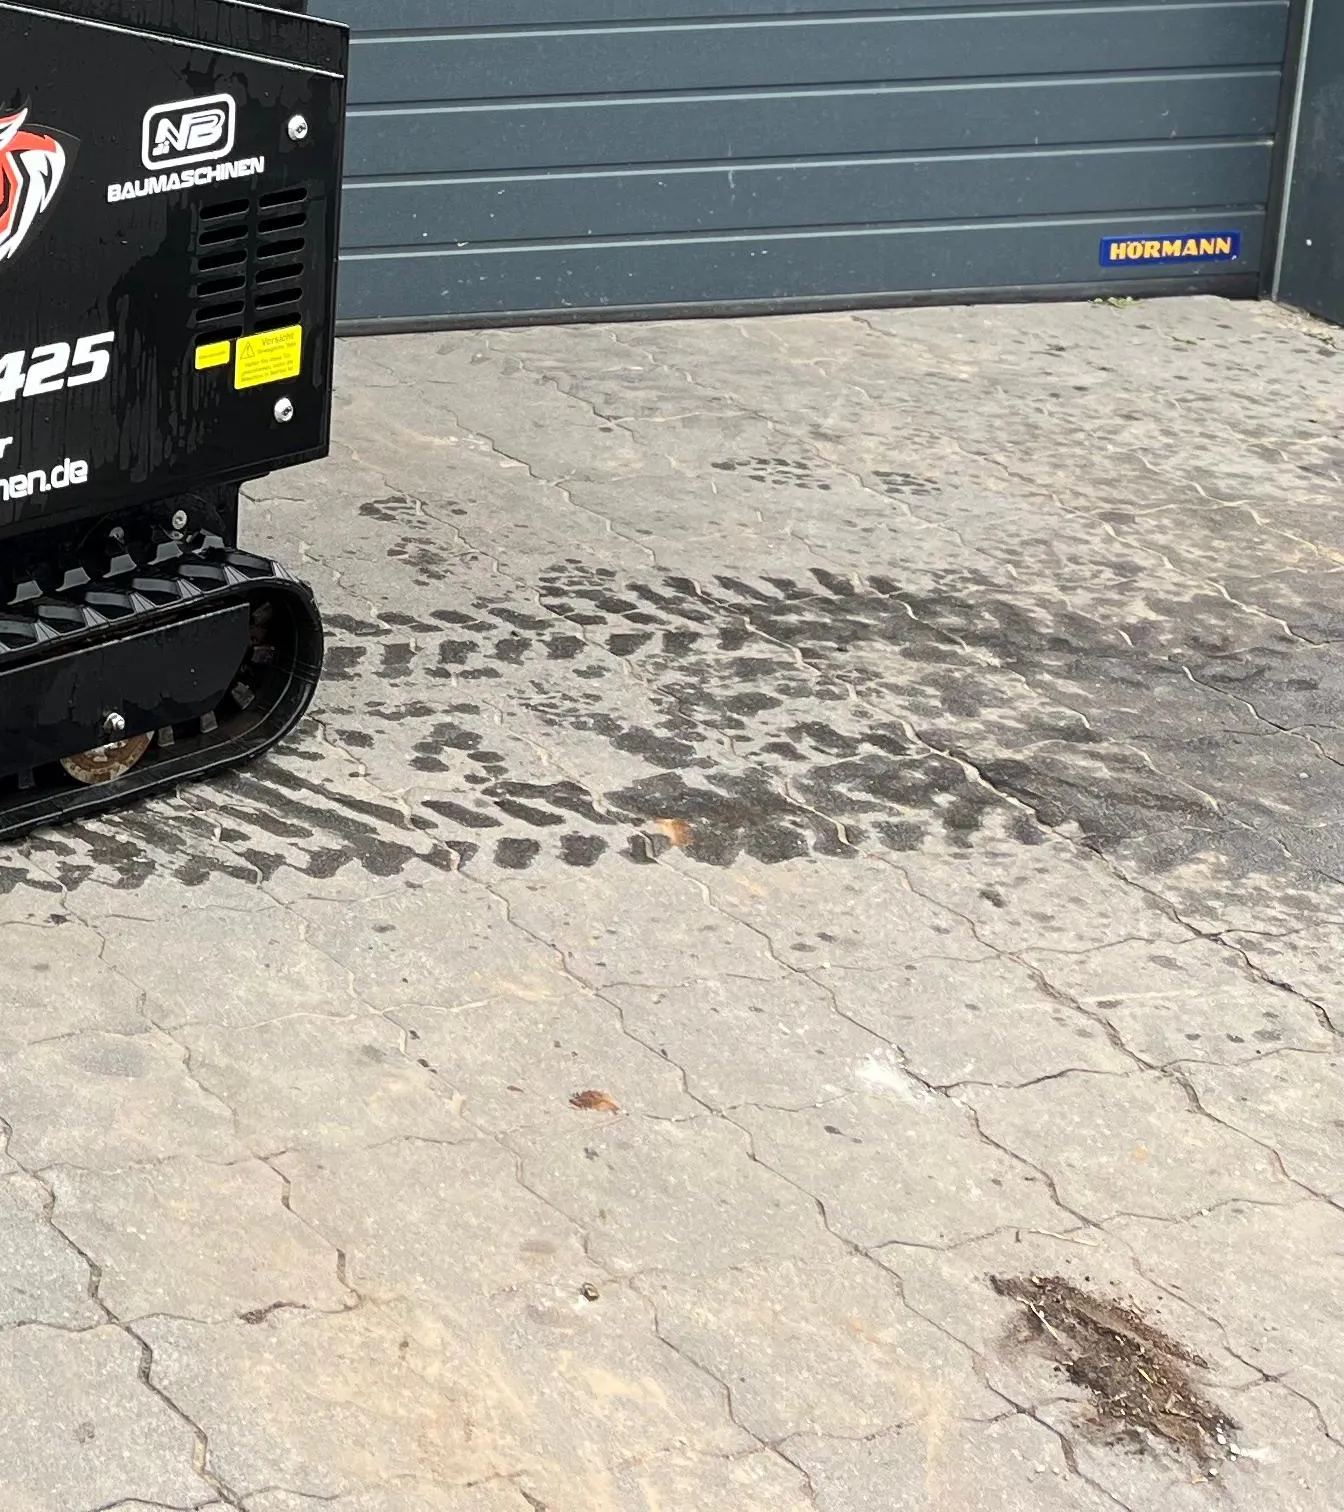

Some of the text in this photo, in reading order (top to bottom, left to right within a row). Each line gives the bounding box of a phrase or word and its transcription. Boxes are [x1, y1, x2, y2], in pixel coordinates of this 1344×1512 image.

[151, 108, 226, 157] NB
[107, 155, 265, 203] BAUMASCHINEN
[1109, 237, 1232, 261] HÖRMANN
